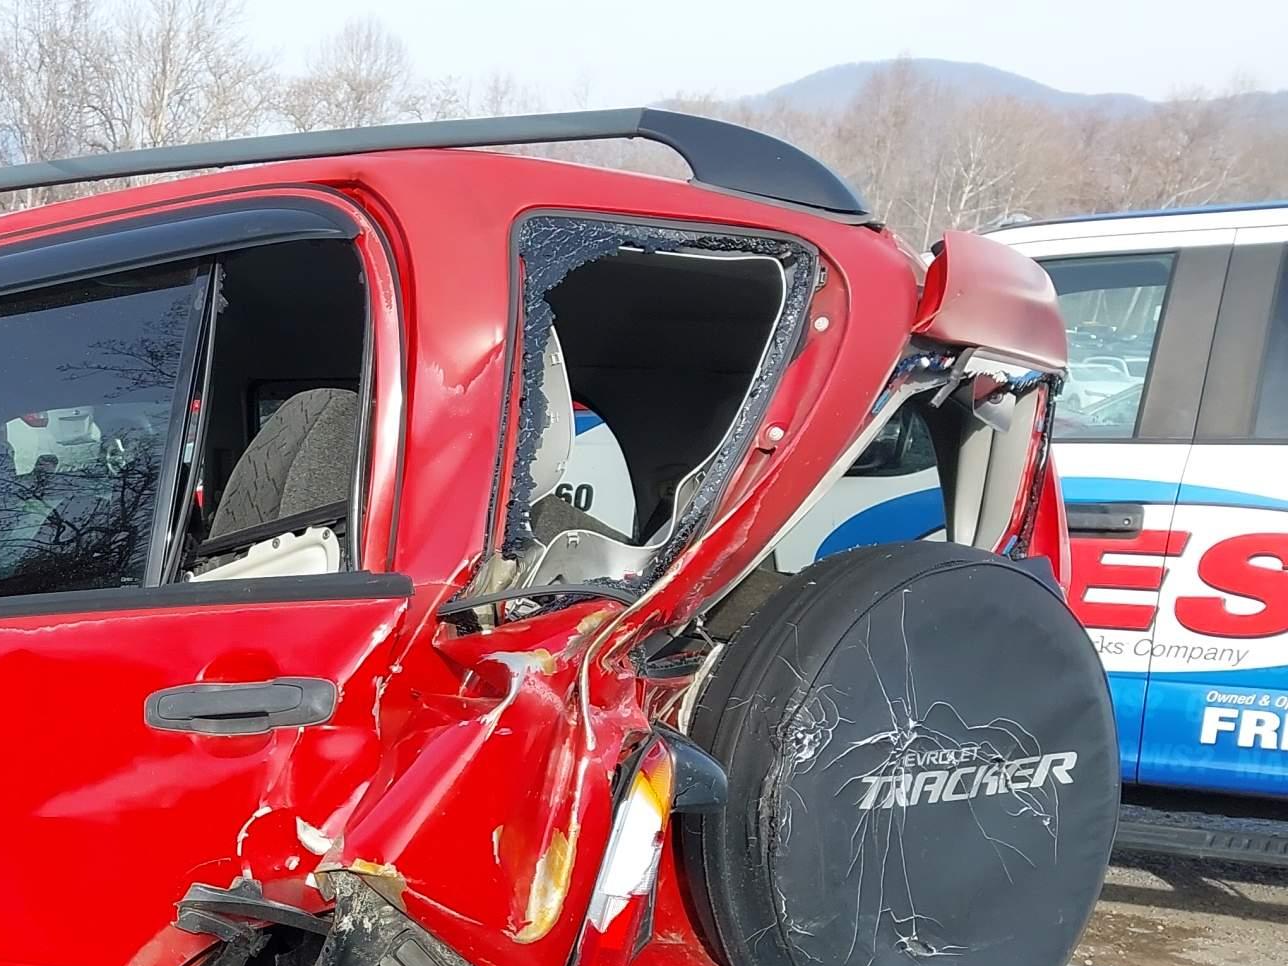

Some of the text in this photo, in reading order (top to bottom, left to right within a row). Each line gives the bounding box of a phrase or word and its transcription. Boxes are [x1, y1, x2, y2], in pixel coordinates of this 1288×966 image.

[555, 483, 593, 512] 60
[1133, 638, 1250, 667] Company
[1206, 690, 1257, 706] Owned
[1259, 694, 1271, 706] &
[1200, 706, 1288, 751] FR
[859, 751, 1078, 810] TRACKER
